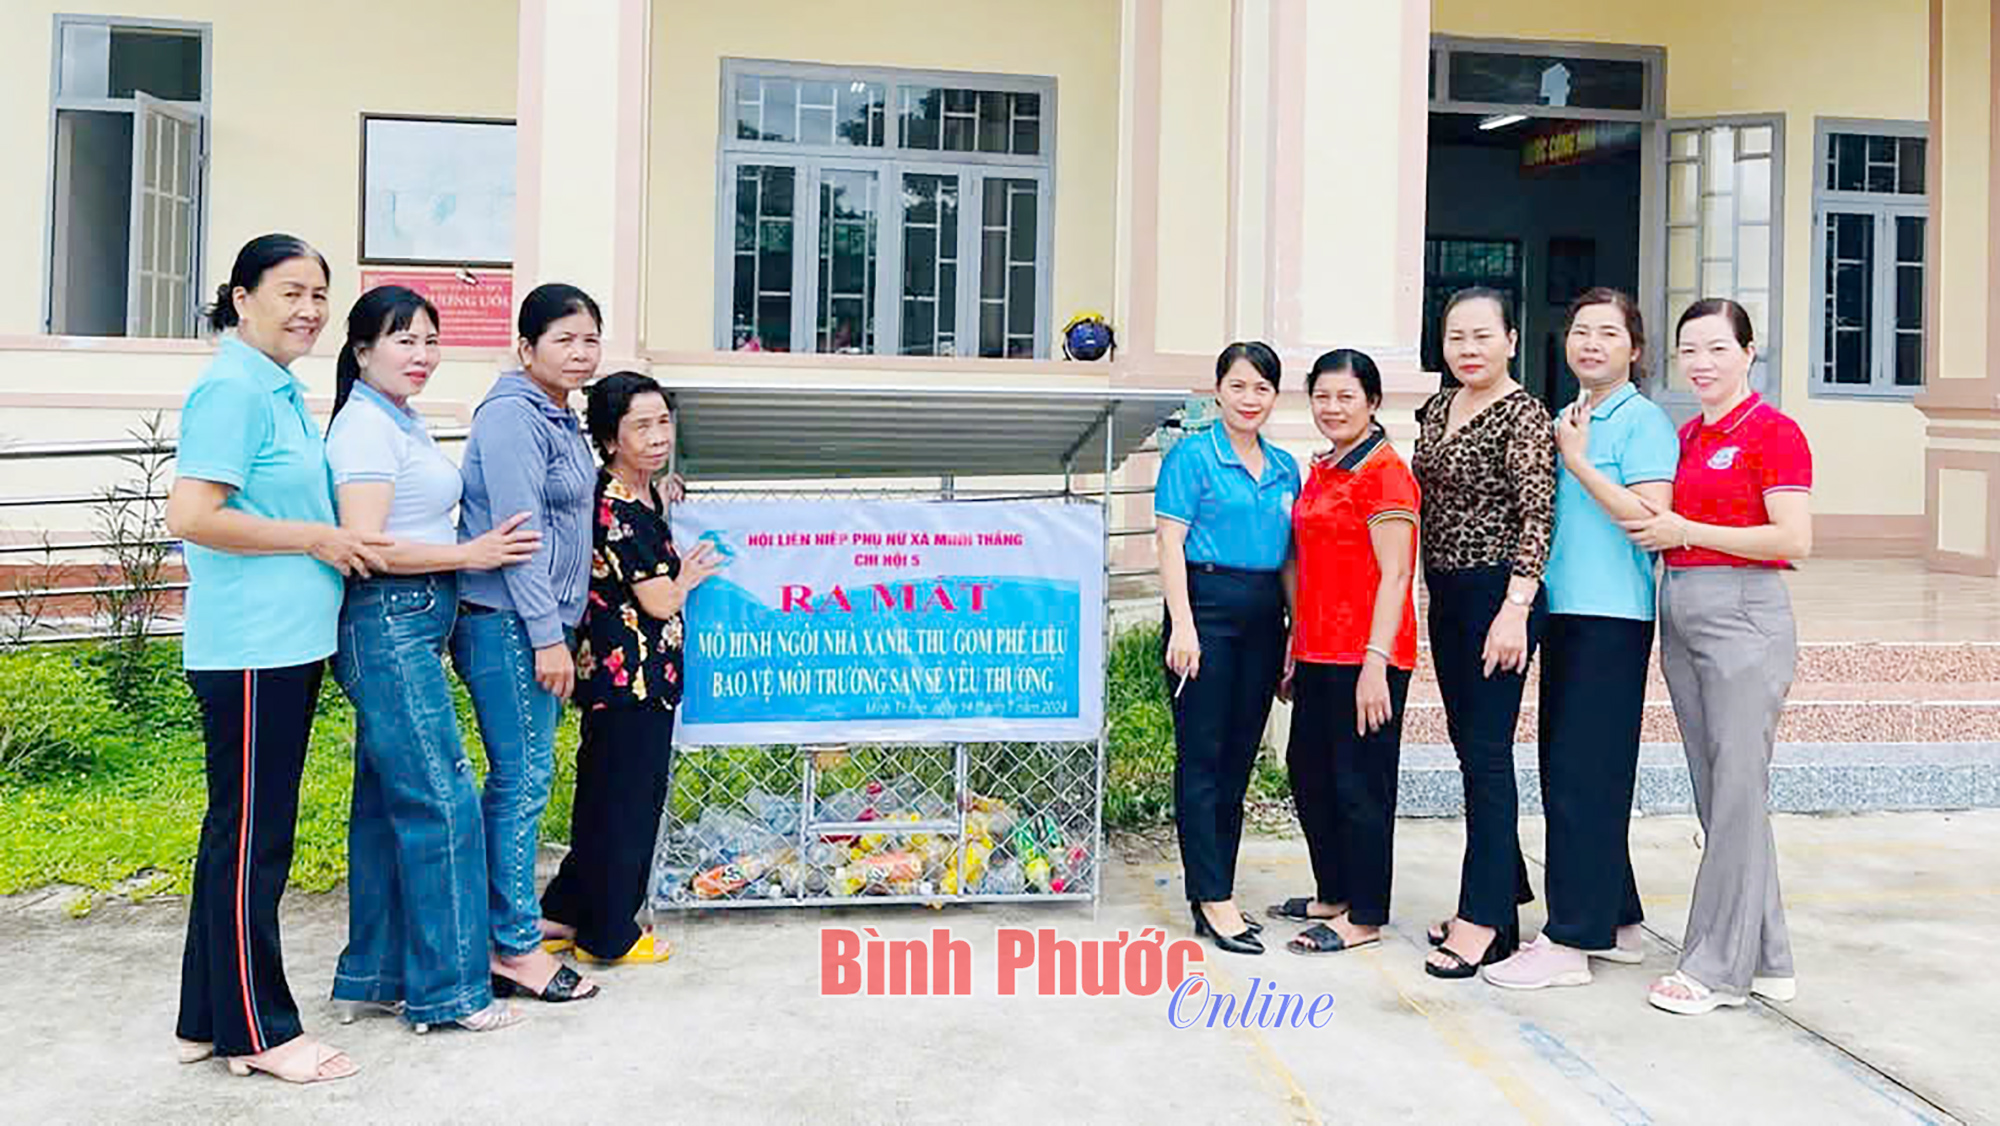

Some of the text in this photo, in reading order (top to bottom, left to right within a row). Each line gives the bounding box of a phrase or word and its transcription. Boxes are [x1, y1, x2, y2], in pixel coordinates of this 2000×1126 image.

[748, 531, 773, 548] HỘI
[777, 531, 810, 546] LIÊN
[852, 532, 882, 549] PHỤ
[854, 551, 920, 570] CHI HỘI 5
[781, 575, 994, 613] RA MẮT
[699, 623, 725, 658] MÔ
[729, 624, 772, 658] HÌNH
[777, 622, 819, 656] NGÔI
[823, 622, 858, 655] NHÀ
[916, 628, 949, 655] THU
[953, 628, 993, 655] GOM
[995, 621, 1028, 655] PHẾ
[1031, 624, 1067, 661] LIỆU
[778, 662, 811, 696] MÔI
